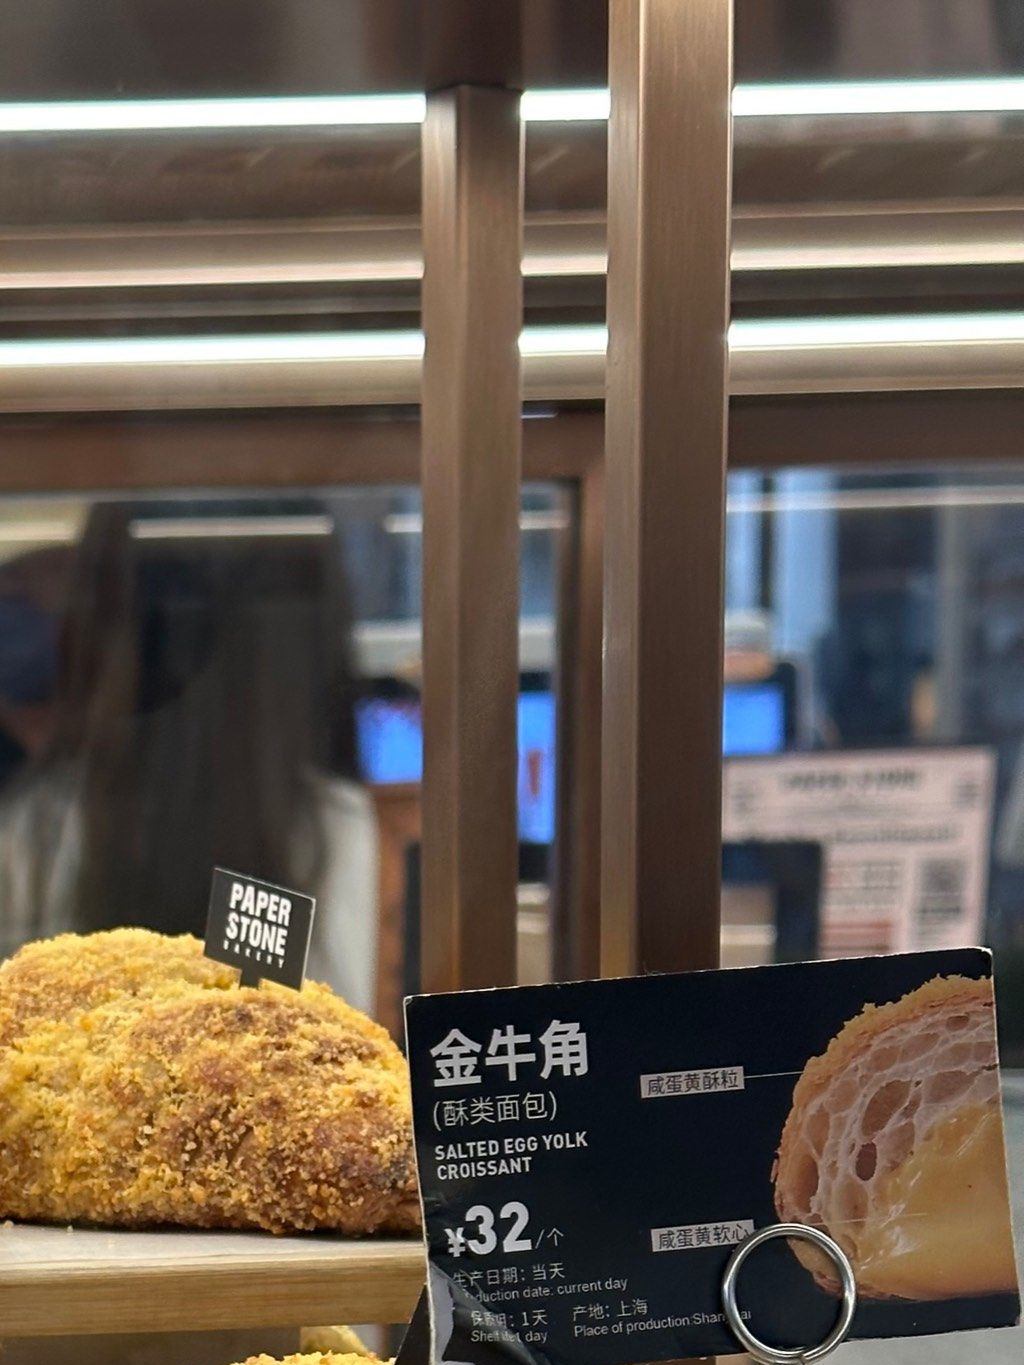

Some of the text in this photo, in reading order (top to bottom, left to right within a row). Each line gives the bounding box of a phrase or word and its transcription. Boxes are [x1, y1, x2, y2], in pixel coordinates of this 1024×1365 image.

[229, 882, 292, 927] PAPER
[225, 911, 288, 956] STONE
[222, 939, 285, 969] BAKERY
[429, 1019, 589, 1087] 金牛角
[647, 1069, 739, 1096] 咸蛋黄酥粒
[433, 1090, 557, 1132] (酥类面包)
[434, 1130, 588, 1161] SALTED EGG YOLK
[436, 1156, 532, 1180] CROISSANT
[522, 1285, 553, 1299] date:
[557, 1280, 603, 1295] current
[604, 1277, 628, 1292] day
[572, 1298, 648, 1322] 产地：上海
[525, 1331, 548, 1344] day
[574, 1324, 608, 1337] Place
[611, 1321, 624, 1333] of
